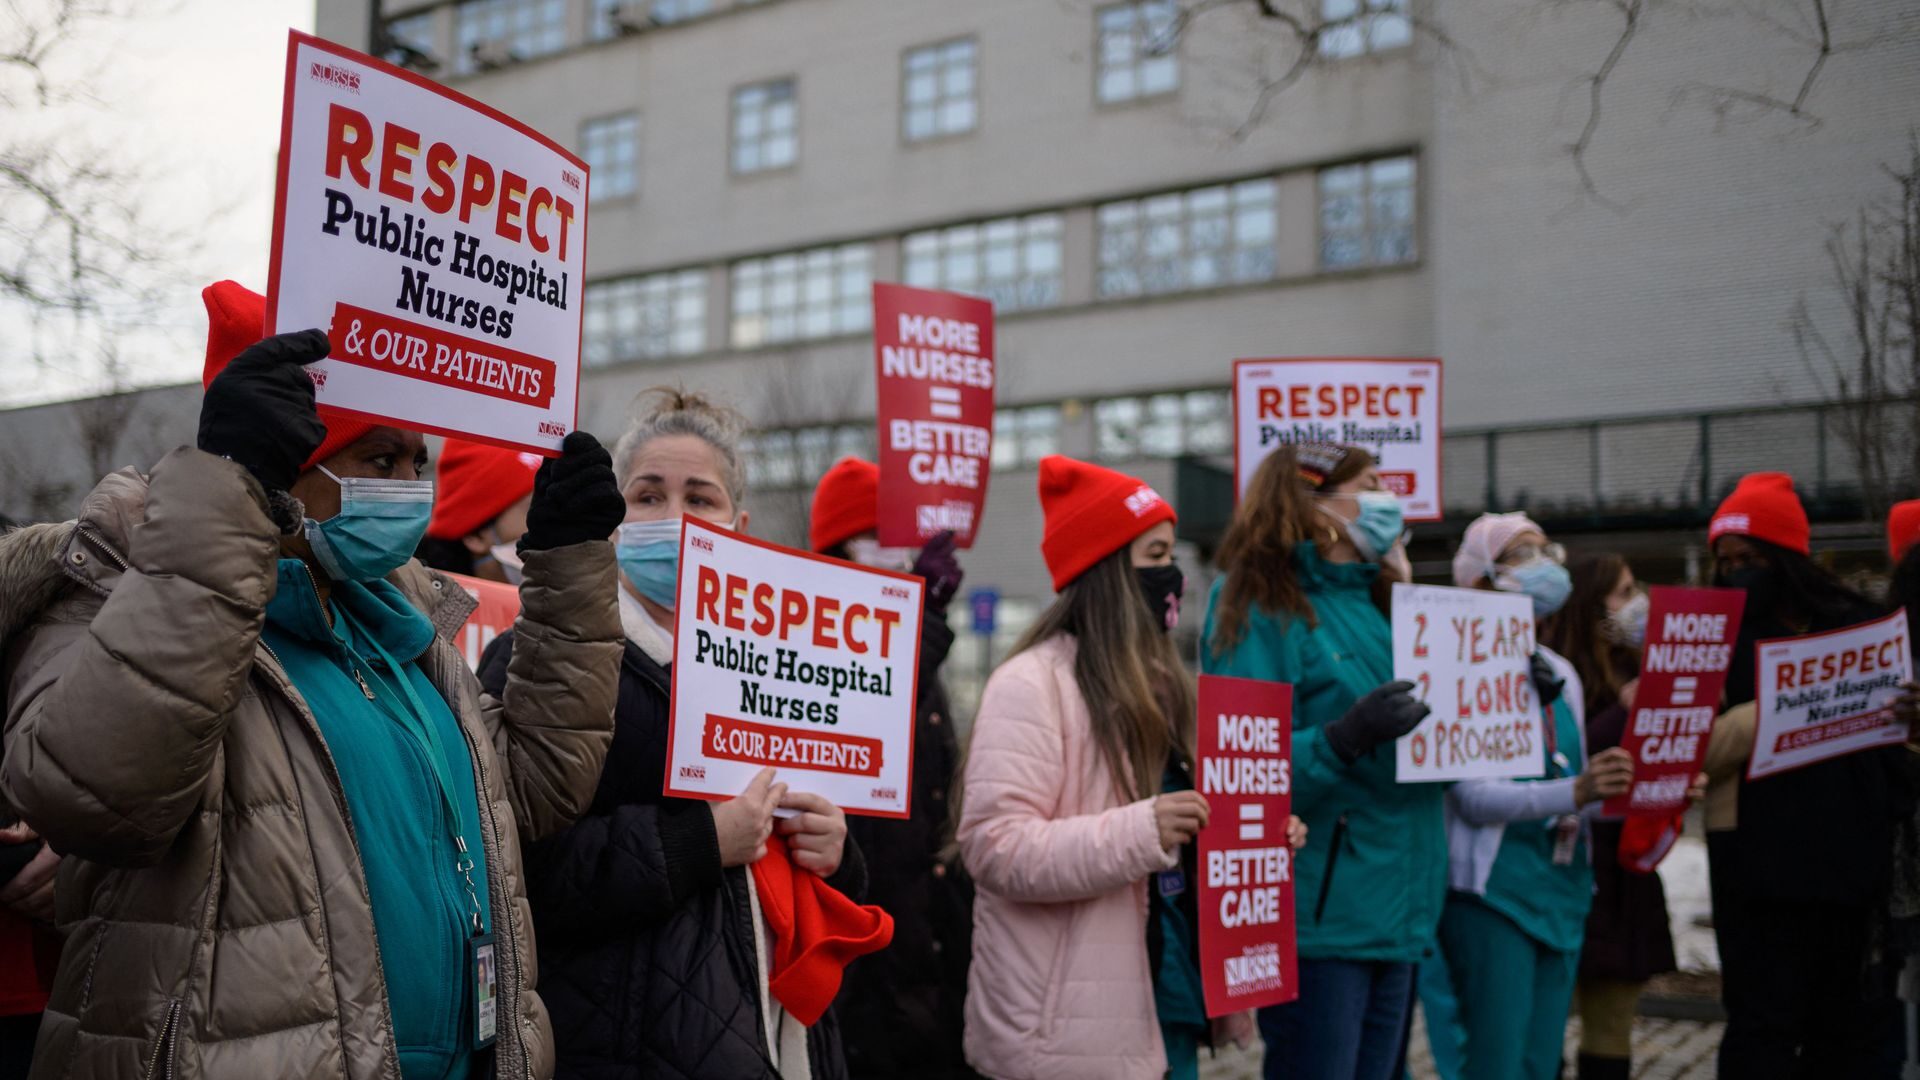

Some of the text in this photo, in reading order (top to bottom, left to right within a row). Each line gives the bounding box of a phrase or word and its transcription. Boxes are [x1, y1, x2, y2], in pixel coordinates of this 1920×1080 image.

[325, 102, 574, 262] RESPECT
[321, 188, 568, 311] Public Hospital
[396, 266, 514, 340] Nurses
[899, 313, 980, 352] MORE
[344, 319, 543, 399] & OUR PATIENTS
[882, 346, 993, 389] NURSES
[1257, 385, 1425, 420] RESPECT
[890, 419, 990, 459] BETTER
[1259, 421, 1422, 447] Public Hospital
[908, 453, 979, 488] CARE
[695, 564, 901, 659] RESPECT
[1662, 612, 1728, 642] MORE
[1413, 613, 1531, 664] 2 YEARS
[1646, 644, 1731, 673] NURSES
[695, 629, 893, 698] Public Hospital
[1775, 634, 1904, 692] RESPECT
[739, 680, 839, 725] Nurses
[1457, 671, 1530, 719] LONG
[1774, 688, 1831, 715] Public
[1806, 699, 1869, 724] Nurses
[1217, 713, 1280, 753] MORE
[1633, 706, 1714, 736] BETTER
[712, 723, 872, 771] & OUR PATIENTS
[1434, 720, 1533, 769] PROGRESS
[1640, 736, 1698, 765] CARE
[1202, 757, 1290, 795] NURSES
[1207, 847, 1290, 888] BETTER
[1220, 887, 1280, 928] CARE
